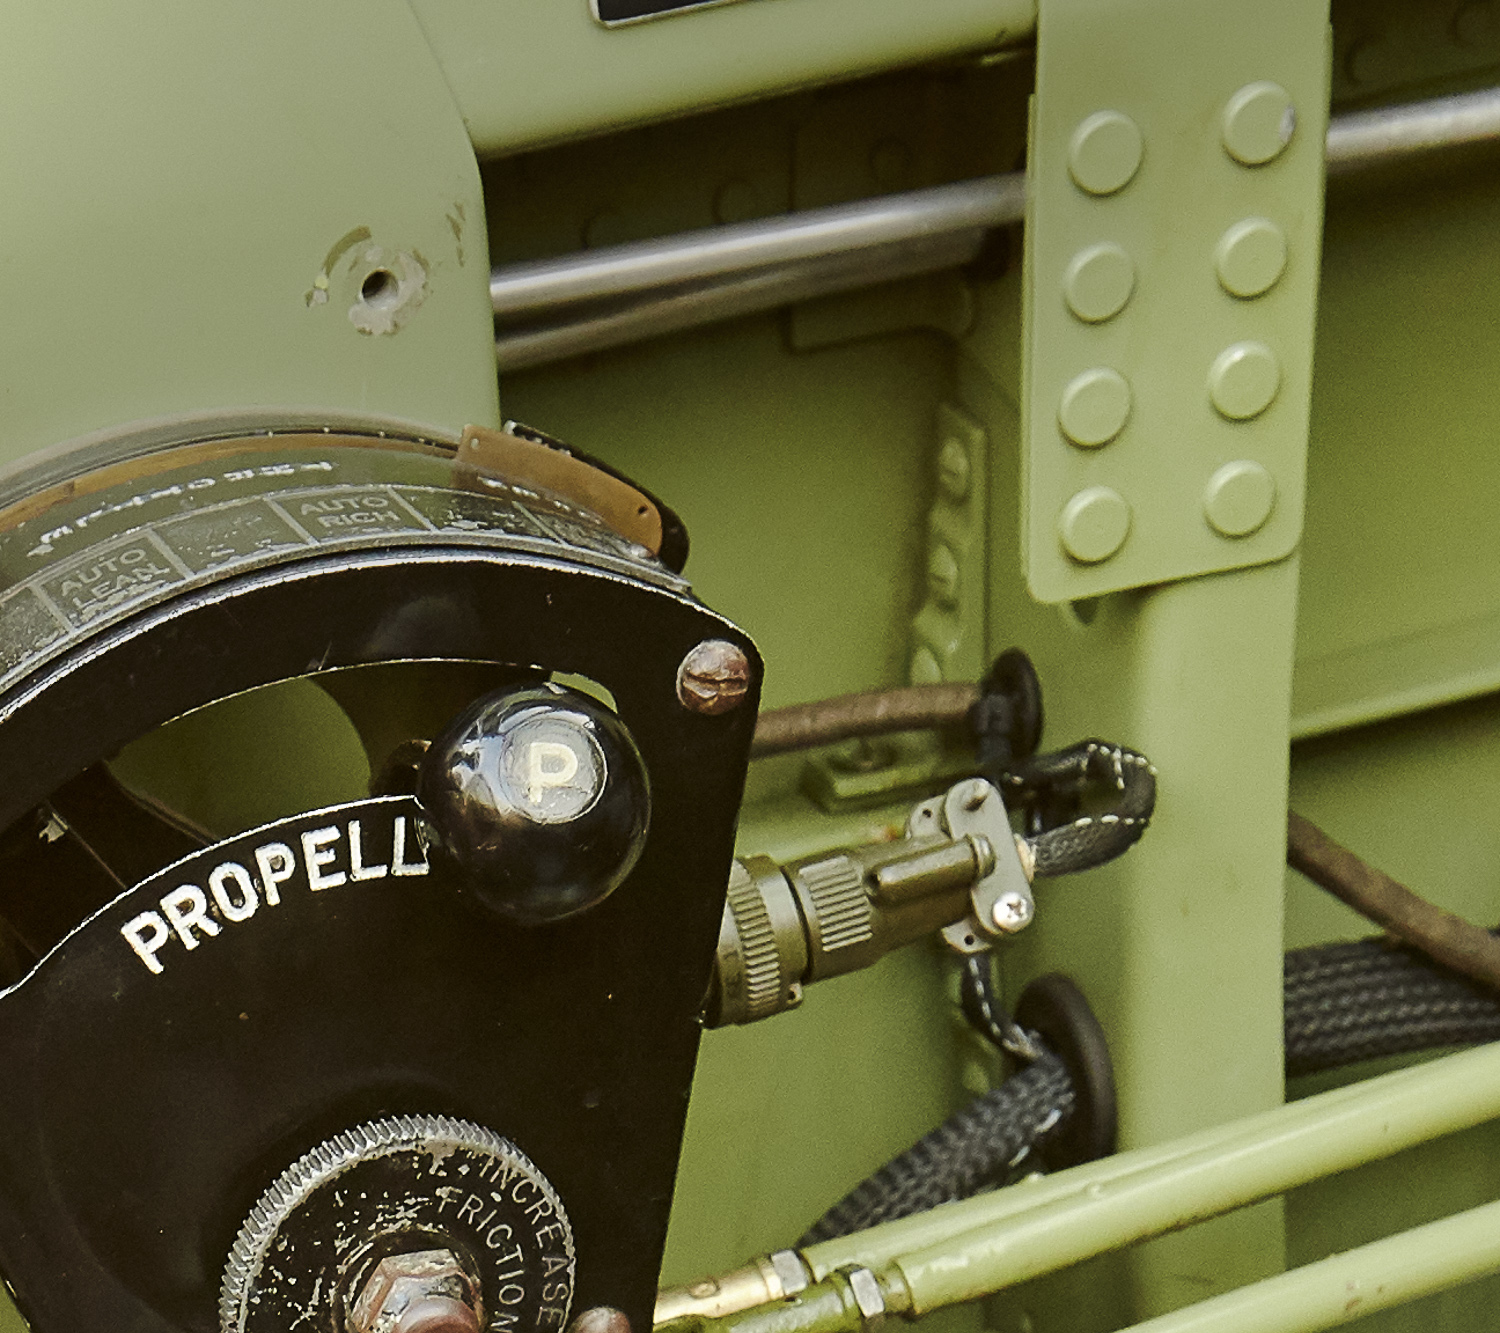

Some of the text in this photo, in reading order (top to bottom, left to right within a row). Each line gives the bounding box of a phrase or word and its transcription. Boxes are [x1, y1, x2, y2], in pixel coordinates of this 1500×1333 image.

[528, 740, 579, 803] P
[120, 814, 430, 976] PROPELL
[478, 1154, 571, 1327] INCREASE
